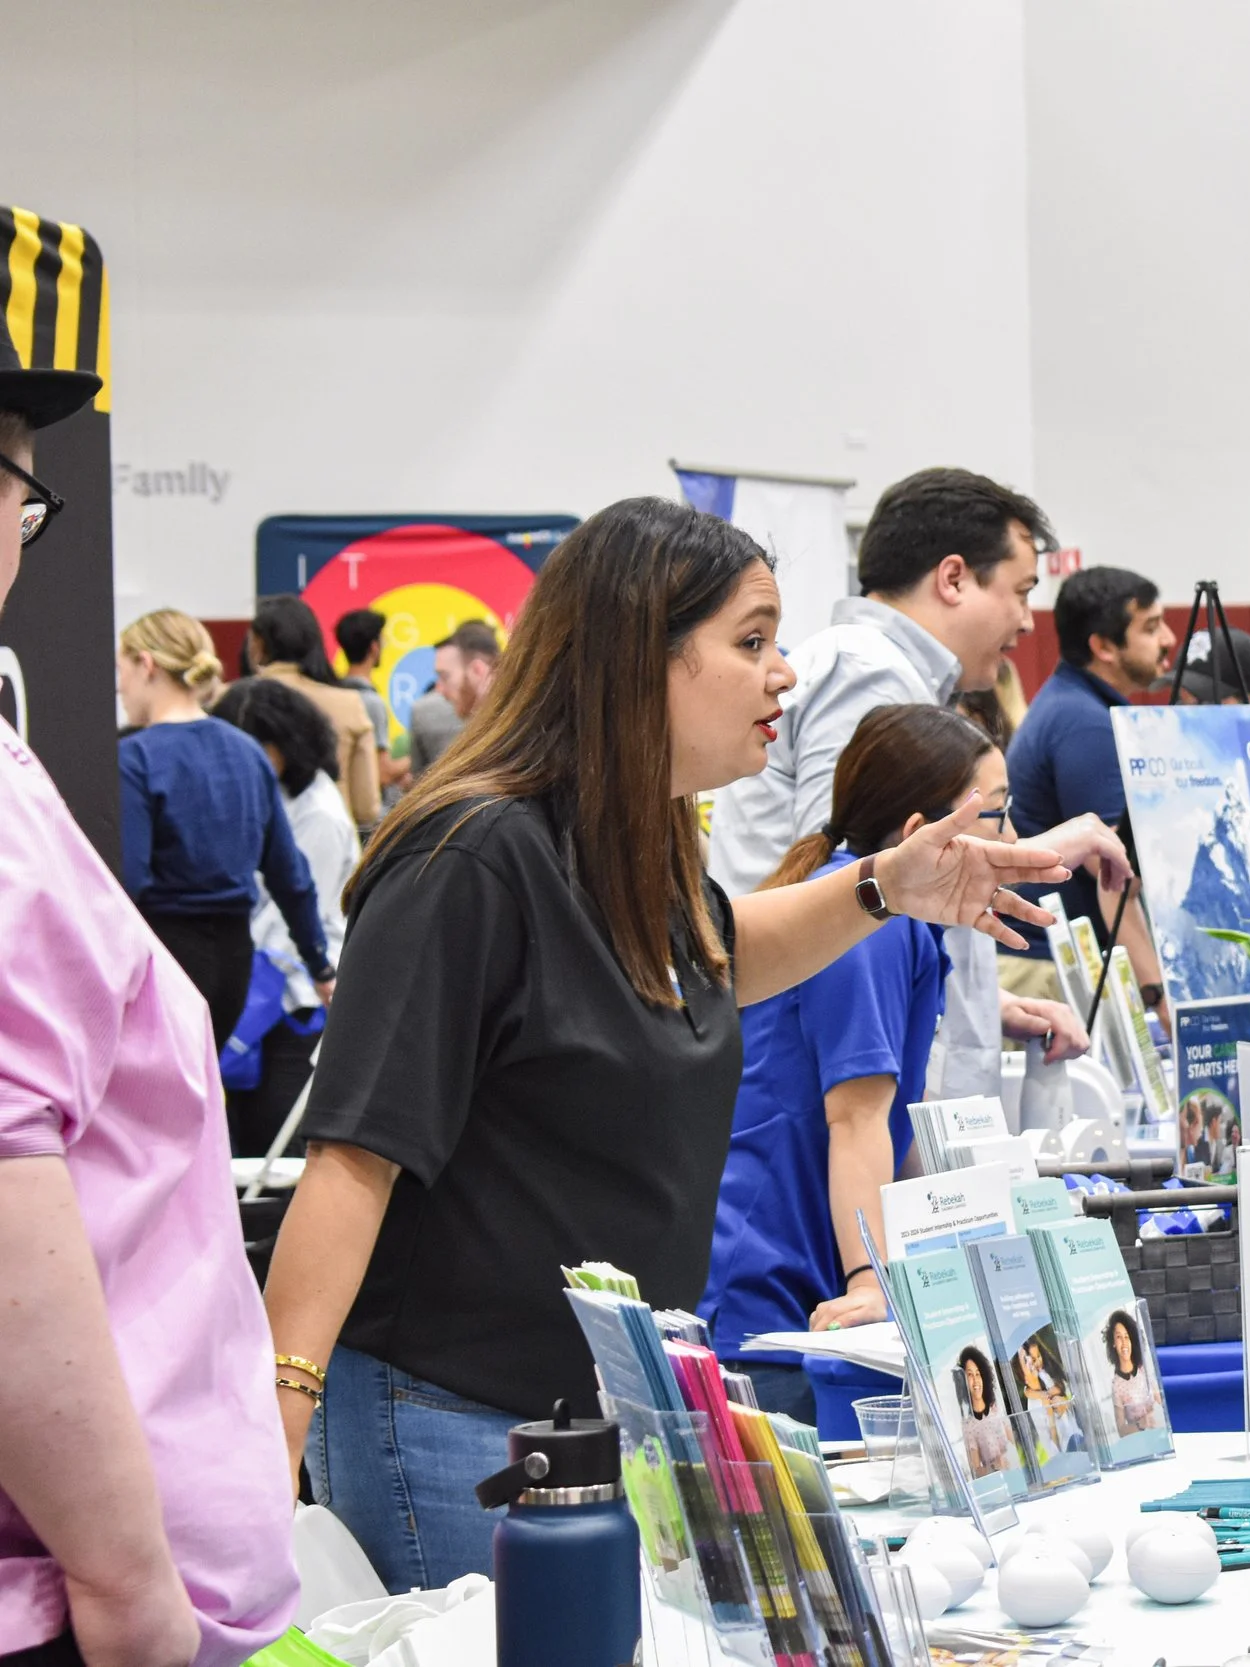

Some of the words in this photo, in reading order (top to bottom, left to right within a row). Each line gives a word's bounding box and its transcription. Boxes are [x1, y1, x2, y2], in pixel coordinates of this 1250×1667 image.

[1186, 1044, 1213, 1060] YOUR
[1188, 1061, 1223, 1079] STARTS
[1223, 1059, 1238, 1074] HE
[939, 1192, 966, 1206] Rebekah
